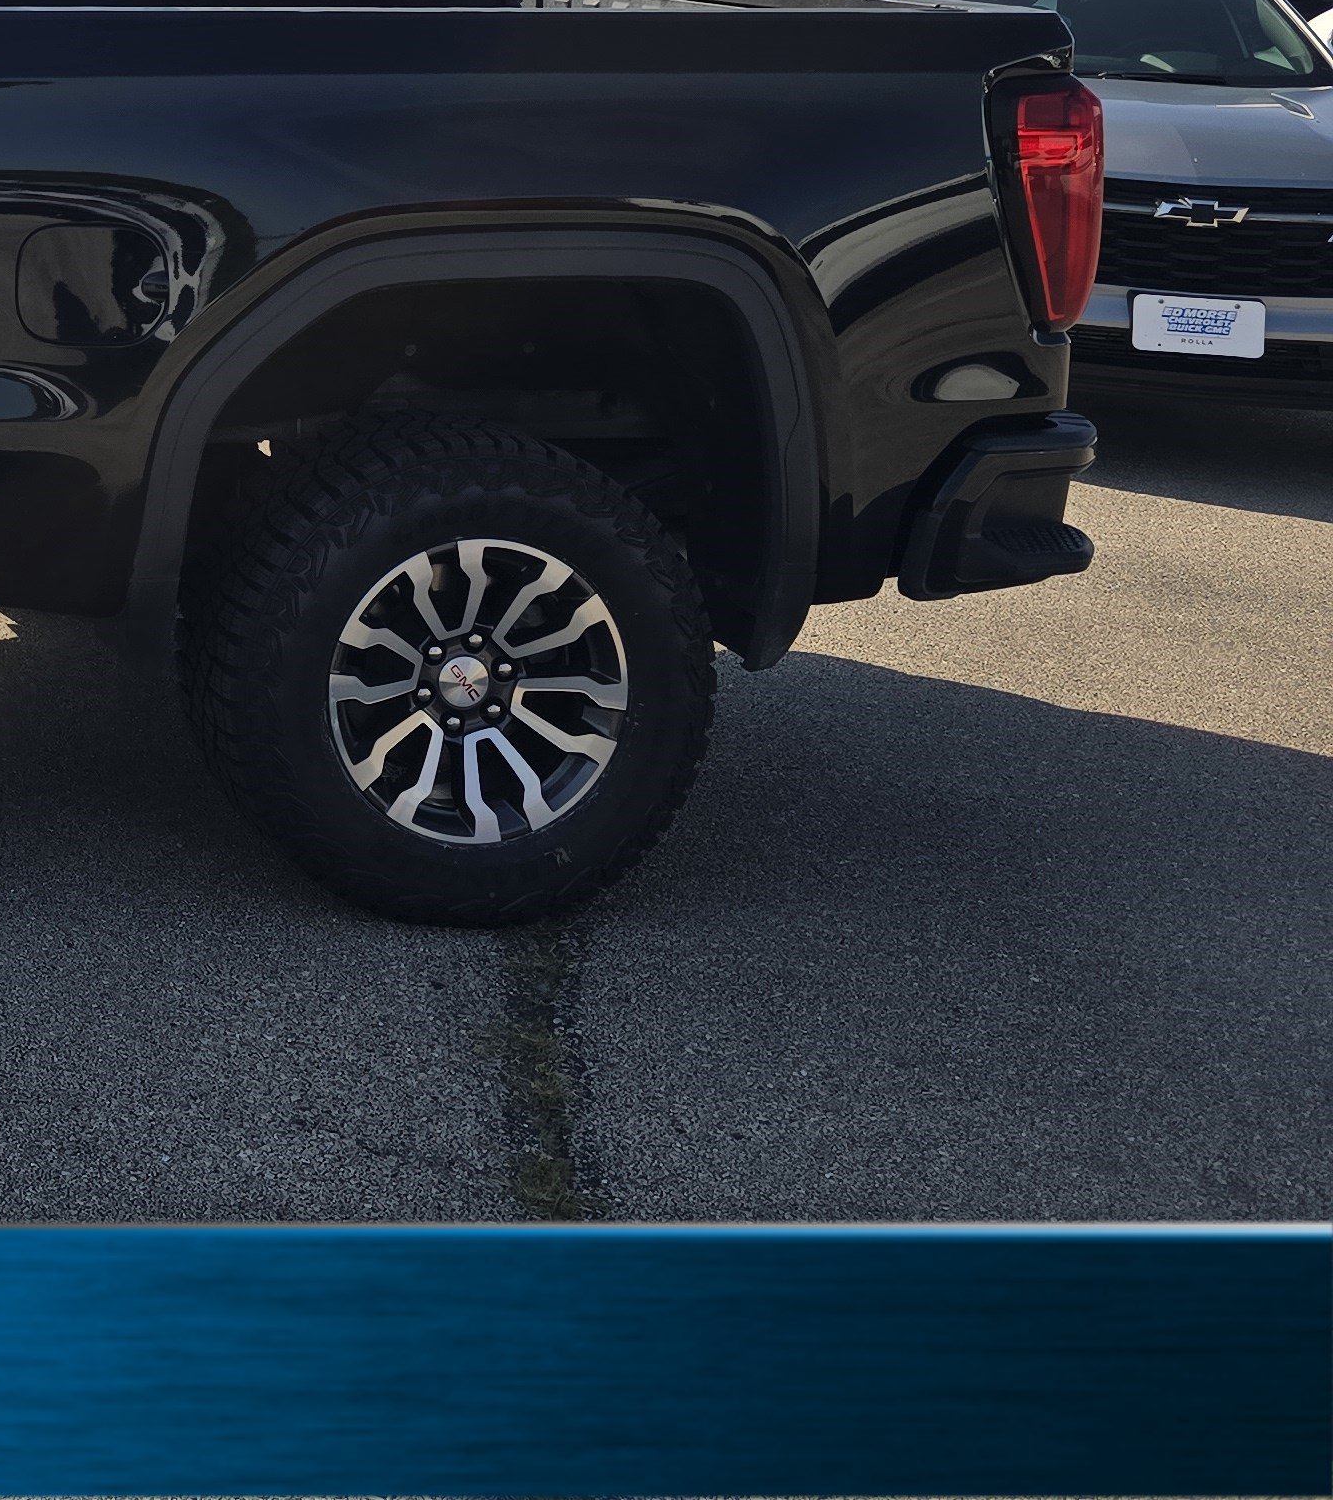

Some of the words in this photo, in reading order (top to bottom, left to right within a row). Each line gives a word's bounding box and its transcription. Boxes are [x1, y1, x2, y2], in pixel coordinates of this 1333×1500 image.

[1162, 306, 1183, 317] ED
[1183, 308, 1237, 322] MORSE
[1180, 338, 1214, 346] ROLLA
[450, 664, 481, 702] GMC
